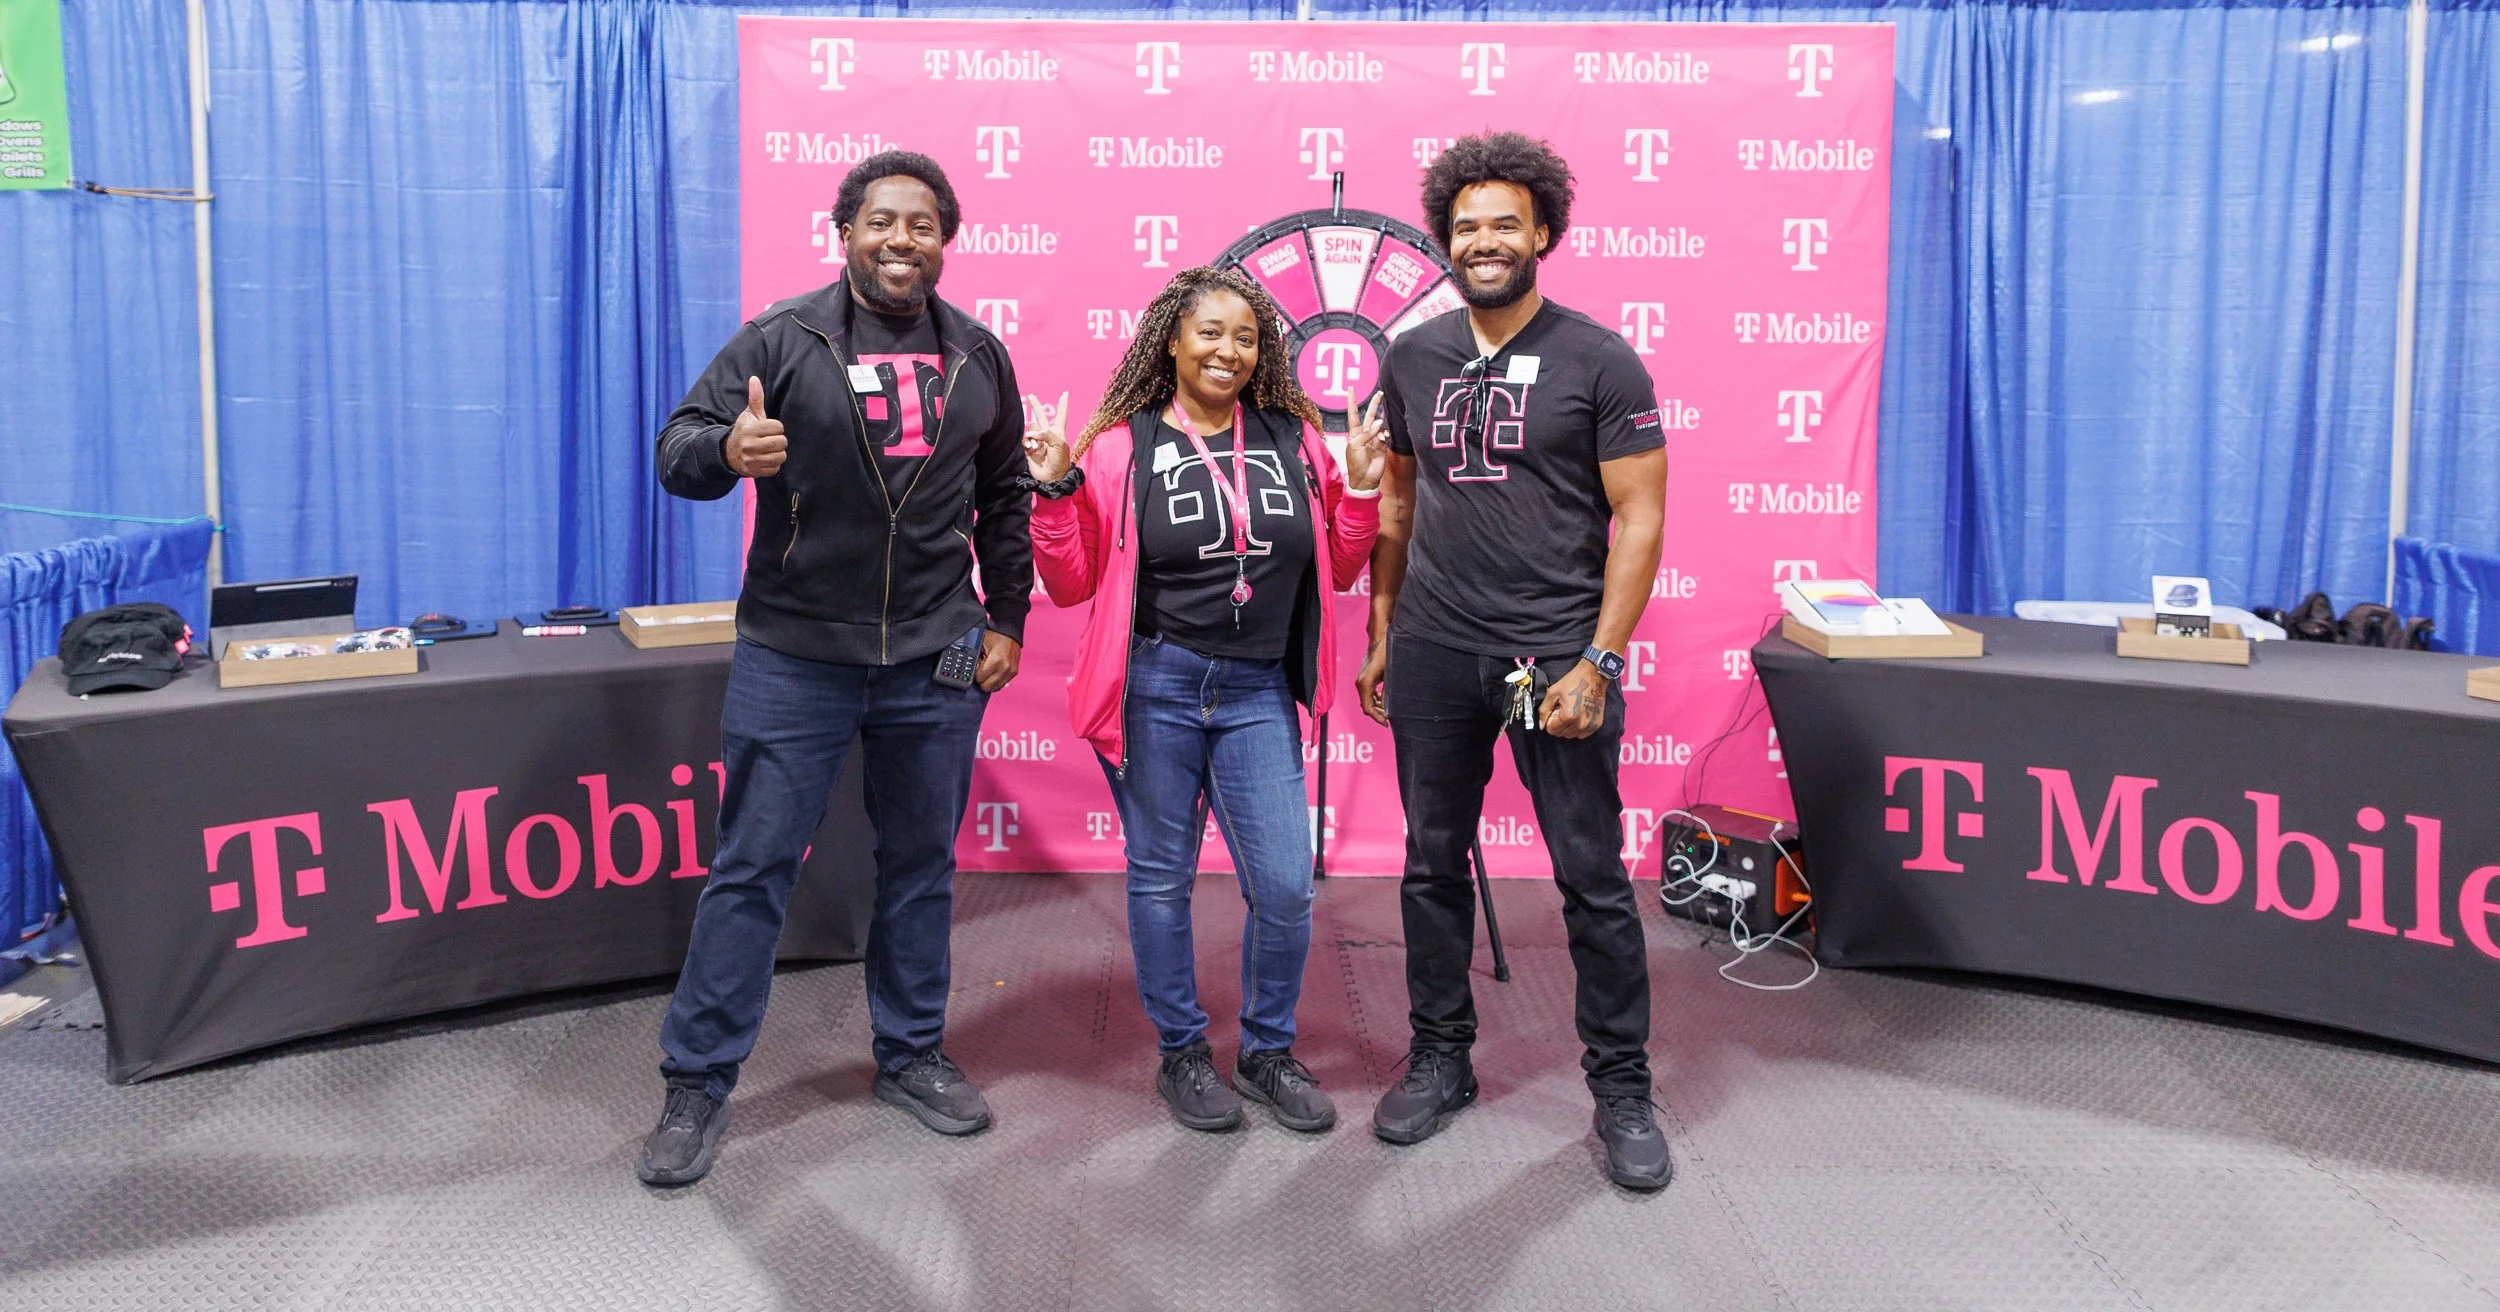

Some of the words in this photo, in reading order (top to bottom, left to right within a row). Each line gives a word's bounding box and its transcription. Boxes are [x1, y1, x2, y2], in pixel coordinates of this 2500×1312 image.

[811, 38, 854, 90] T
[924, 49, 949, 79] T
[955, 50, 1058, 80] Mobile
[1136, 42, 1180, 94] T
[1250, 51, 1274, 81] T
[1280, 51, 1383, 82] Mobile
[1461, 43, 1505, 95] T
[1574, 52, 1600, 83] T
[1606, 52, 1709, 84] Mobile
[1788, 44, 1833, 97] T
[766, 132, 790, 162] T
[976, 126, 1020, 178] T
[1089, 137, 1114, 167] T
[1120, 137, 1222, 167] Mobile
[1300, 128, 1343, 181] T
[1625, 129, 1668, 181] T
[1738, 140, 1764, 170] T
[1770, 140, 1873, 170] Mobile
[4, 166, 45, 178] Grills
[956, 224, 1057, 254] Mobile
[1135, 216, 1178, 267] T
[1325, 237, 1362, 251] SPIN
[1571, 227, 1596, 257] T
[1602, 227, 1705, 258] Mobile
[1783, 219, 1827, 271] T
[1257, 243, 1297, 268] SWAG
[1324, 253, 1362, 264] AGAIN
[1388, 252, 1425, 277] GREAT
[1374, 269, 1412, 299] DEALS
[1380, 261, 1419, 291] PHONE
[1088, 309, 1112, 339] T
[1621, 302, 1664, 355] T
[1735, 313, 1760, 343] T
[1766, 313, 1870, 343] Mobile
[1316, 343, 1360, 396] T
[1432, 376, 1530, 482] T
[1659, 398, 1700, 430] ile
[1778, 391, 1822, 442] T
[1163, 449, 1294, 560] T
[1729, 484, 1754, 513] T
[1760, 483, 1861, 513] Mobile
[1650, 567, 1697, 599] ile
[1723, 650, 1748, 679] T
[1302, 734, 1373, 763] obile
[1619, 735, 1691, 765] obile
[977, 802, 1018, 852] T
[1087, 812, 1111, 840] T
[1885, 756, 1983, 872] T
[1478, 816, 1535, 847] bile
[204, 812, 325, 947] T
[367, 762, 725, 922] Mobi
